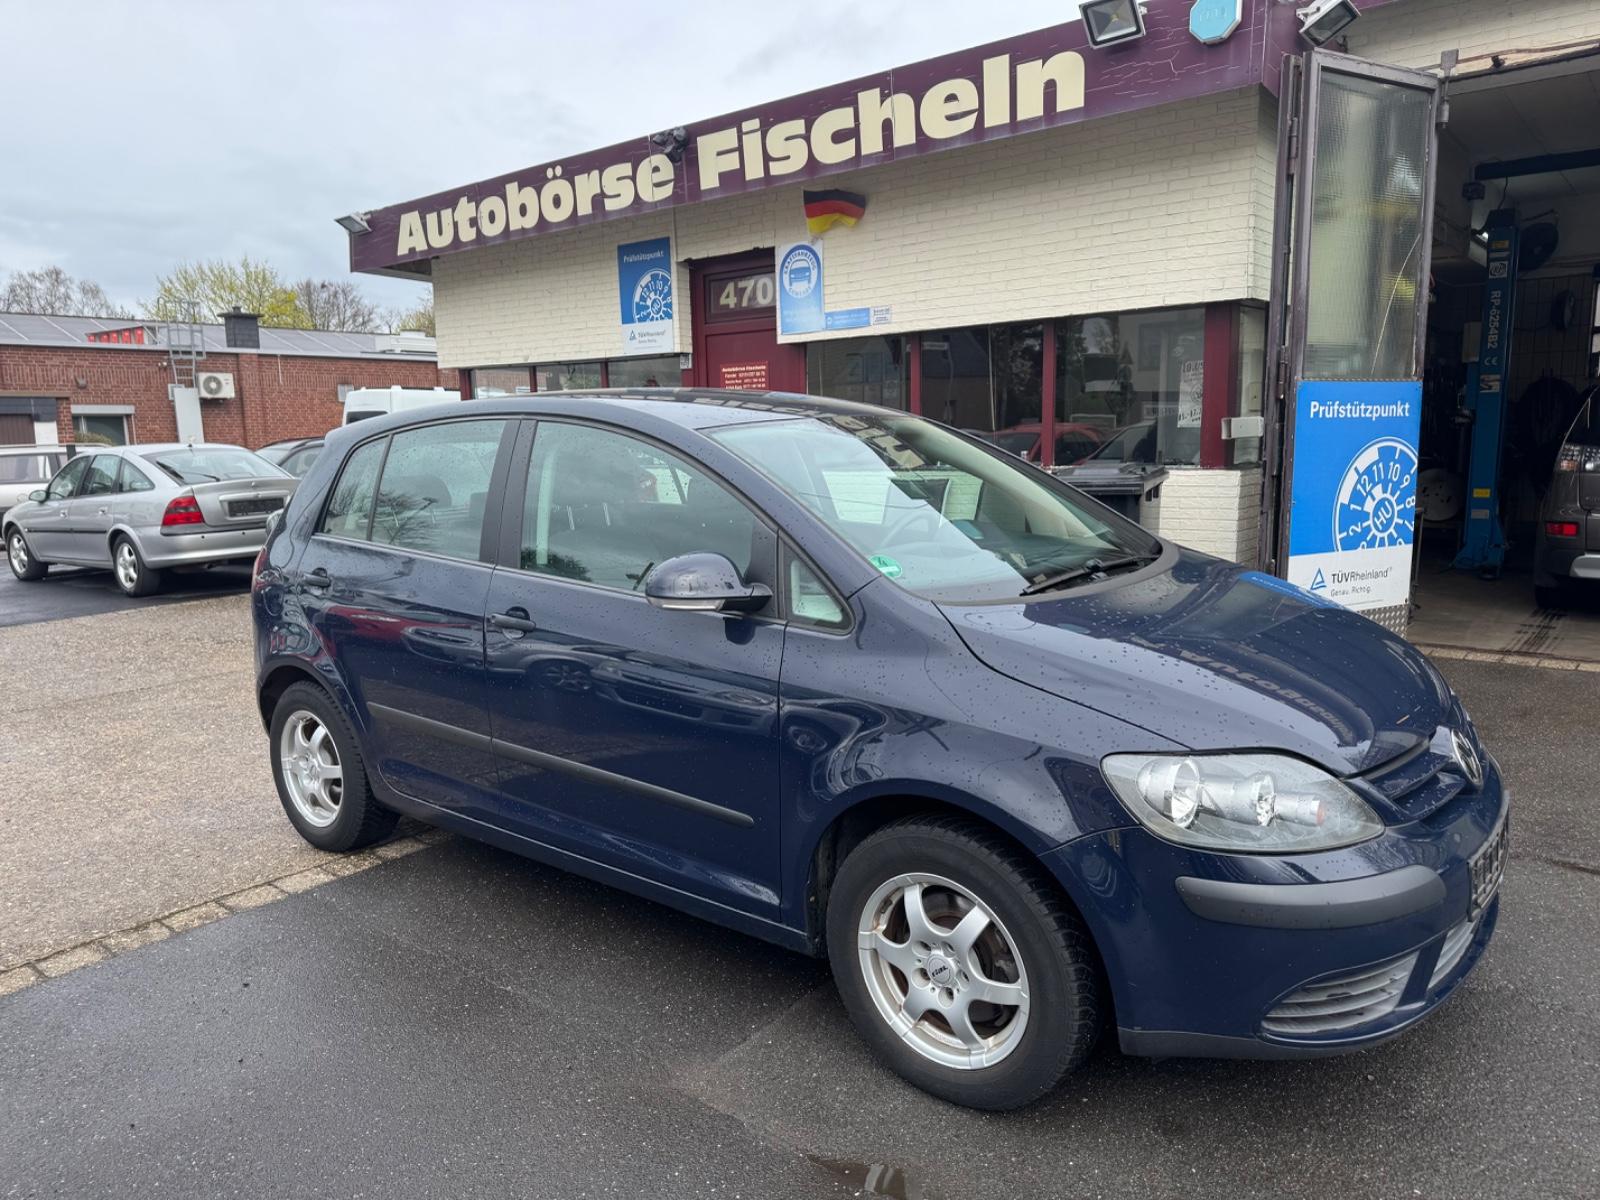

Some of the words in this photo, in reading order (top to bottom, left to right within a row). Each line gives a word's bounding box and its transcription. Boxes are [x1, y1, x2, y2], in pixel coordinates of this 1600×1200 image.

[397, 153, 674, 256] Autobörse
[697, 51, 1085, 190] Fischeln
[720, 277, 773, 308] 470
[1309, 399, 1410, 421] Prüfstützpunkt
[1372, 462, 1384, 482] 11
[1388, 461, 1401, 482] 10
[1400, 475, 1410, 489] 9
[1357, 475, 1373, 497] 12
[1374, 501, 1393, 531] HU
[1349, 522, 1362, 536] 2
